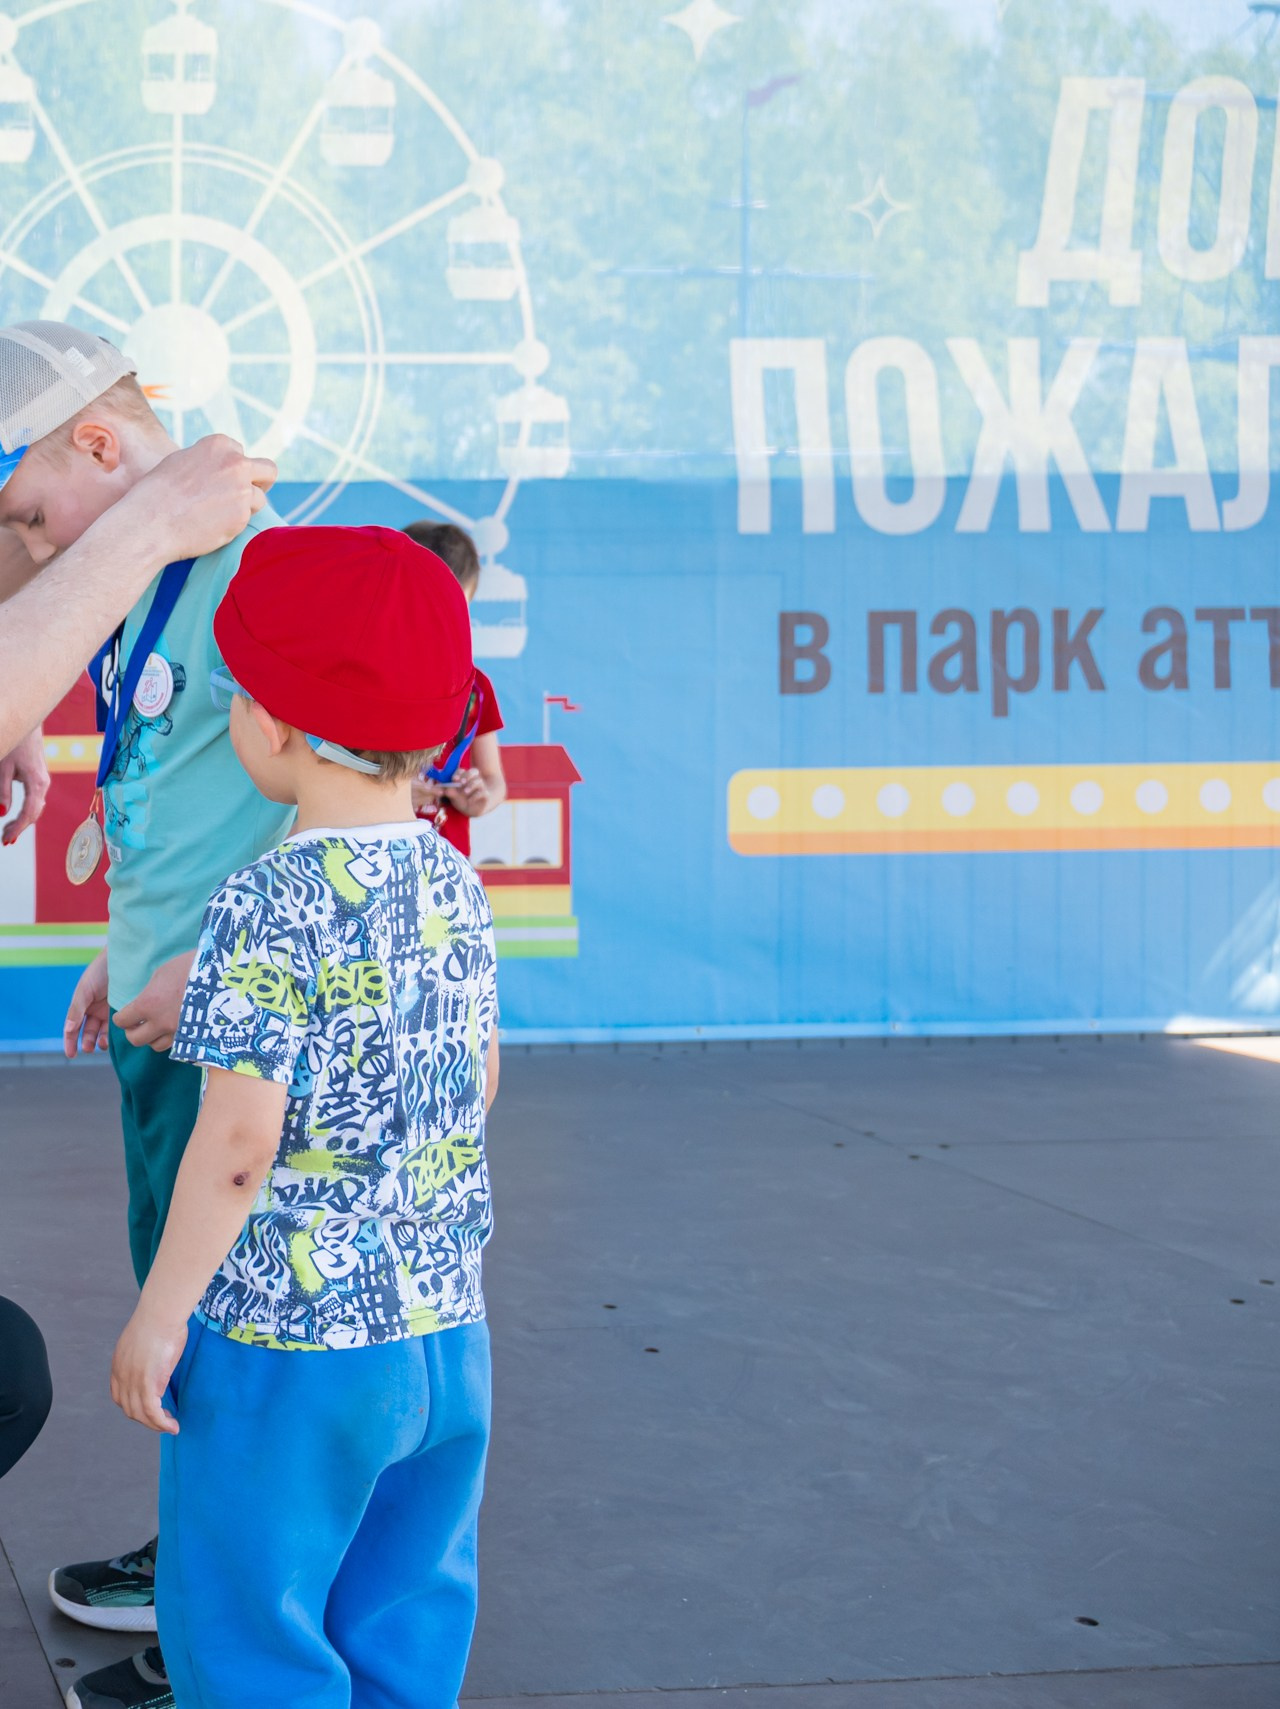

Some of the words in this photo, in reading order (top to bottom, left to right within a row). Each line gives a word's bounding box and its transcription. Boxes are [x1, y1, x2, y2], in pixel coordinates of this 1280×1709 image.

[1016, 75, 1280, 307] ДО
[779, 611, 831, 695] в
[867, 607, 1106, 718] парк
